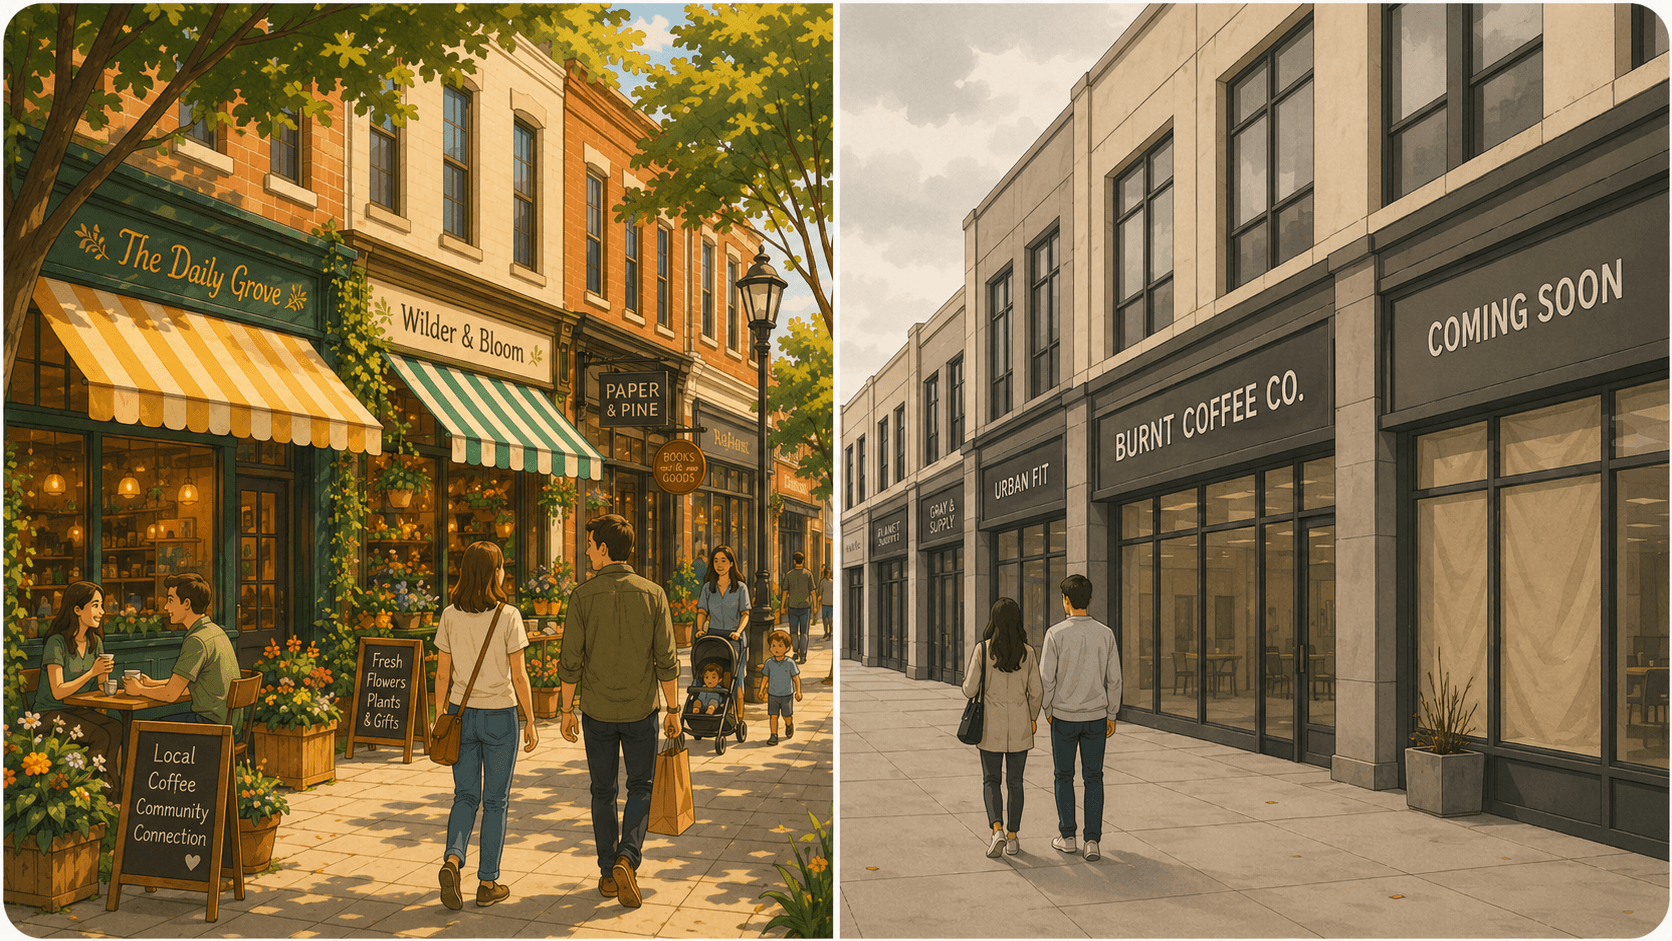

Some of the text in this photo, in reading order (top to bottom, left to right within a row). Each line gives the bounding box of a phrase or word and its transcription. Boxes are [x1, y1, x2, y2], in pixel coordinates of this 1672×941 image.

[118, 228, 281, 306] The Daily Grove
[1427, 257, 1623, 357] COMING SOON
[400, 303, 524, 363] Wilder & Bloom
[606, 382, 660, 399] PAPER
[607, 402, 658, 417] & PINE
[1115, 369, 1304, 462] BURNT COFFEE CO.
[663, 452, 695, 462] BOOKS
[662, 473, 695, 483] GOODS
[994, 462, 1049, 500] URBAN FIT
[929, 515, 955, 534] SUPPLY
[372, 652, 403, 669] Fresh
[366, 672, 407, 689] Flowers
[367, 692, 401, 709] Plants
[363, 712, 399, 730] & Gifts
[153, 743, 196, 765] Local
[148, 771, 196, 794] Coffee
[136, 797, 209, 825] Community
[133, 823, 207, 846] Connection
